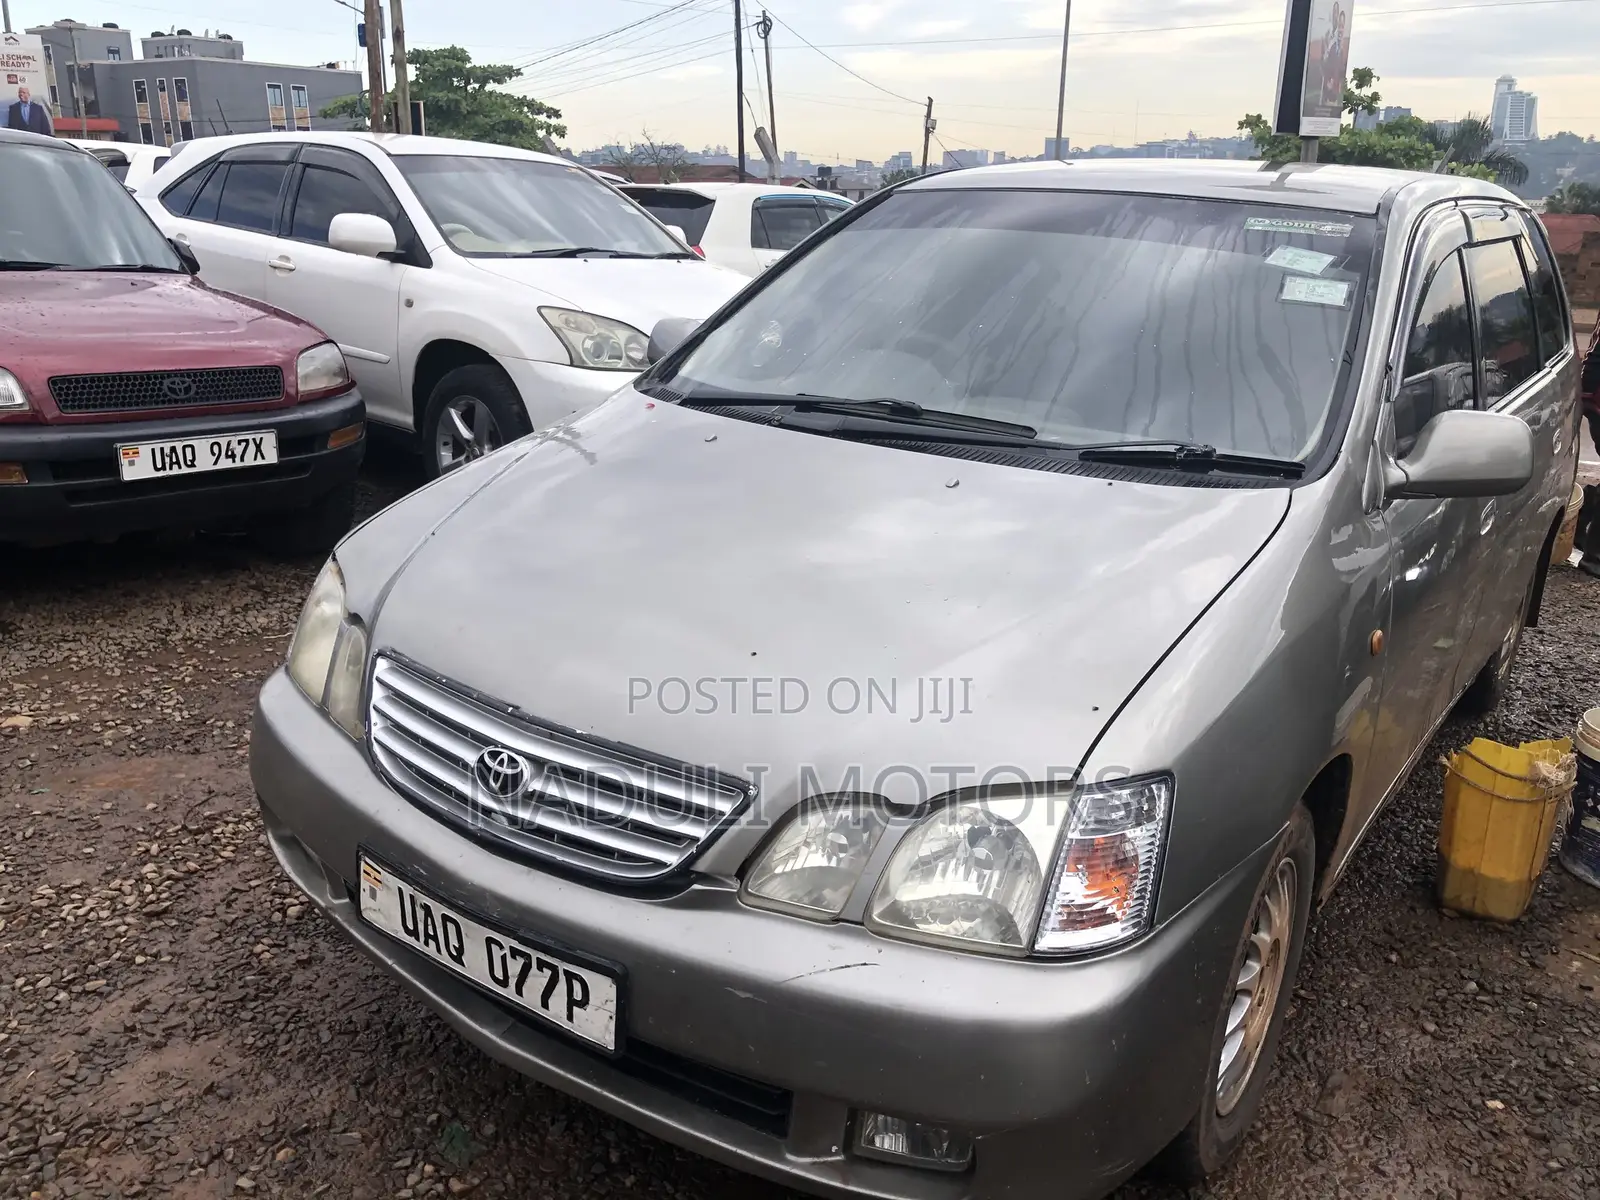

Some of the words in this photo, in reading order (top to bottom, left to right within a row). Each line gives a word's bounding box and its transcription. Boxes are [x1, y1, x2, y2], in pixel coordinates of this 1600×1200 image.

[151, 444, 197, 472] UAQ
[209, 437, 265, 466] 947X
[397, 884, 467, 969] UAQ
[484, 935, 590, 1024] 077P
